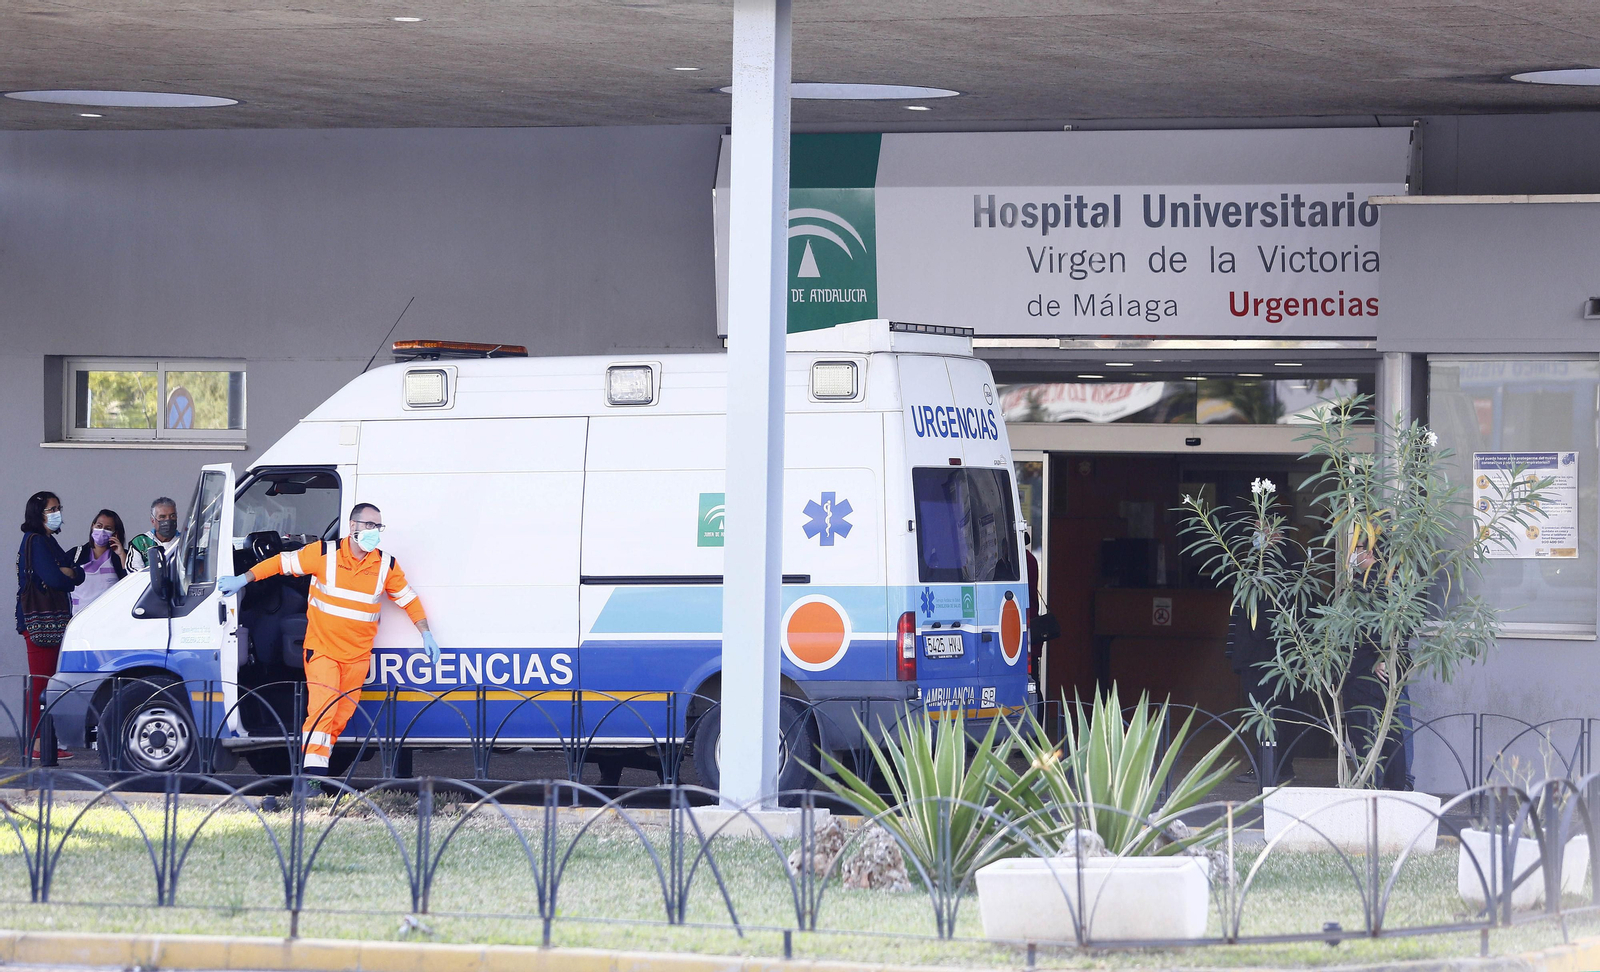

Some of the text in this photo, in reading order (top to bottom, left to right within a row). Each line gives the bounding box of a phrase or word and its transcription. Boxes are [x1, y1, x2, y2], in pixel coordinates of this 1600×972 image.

[974, 192, 1379, 236] Hospital Universitario
[1026, 244, 1380, 280] Virgen de la Victoria
[791, 289, 867, 303] DE ANDALUCIA
[1027, 293, 1178, 322] de Málaga
[1229, 290, 1379, 324] Urgencias
[911, 405, 998, 441] URGENCIAS
[927, 637, 945, 653] 5425
[926, 686, 995, 707] AMBULANCIA SP
